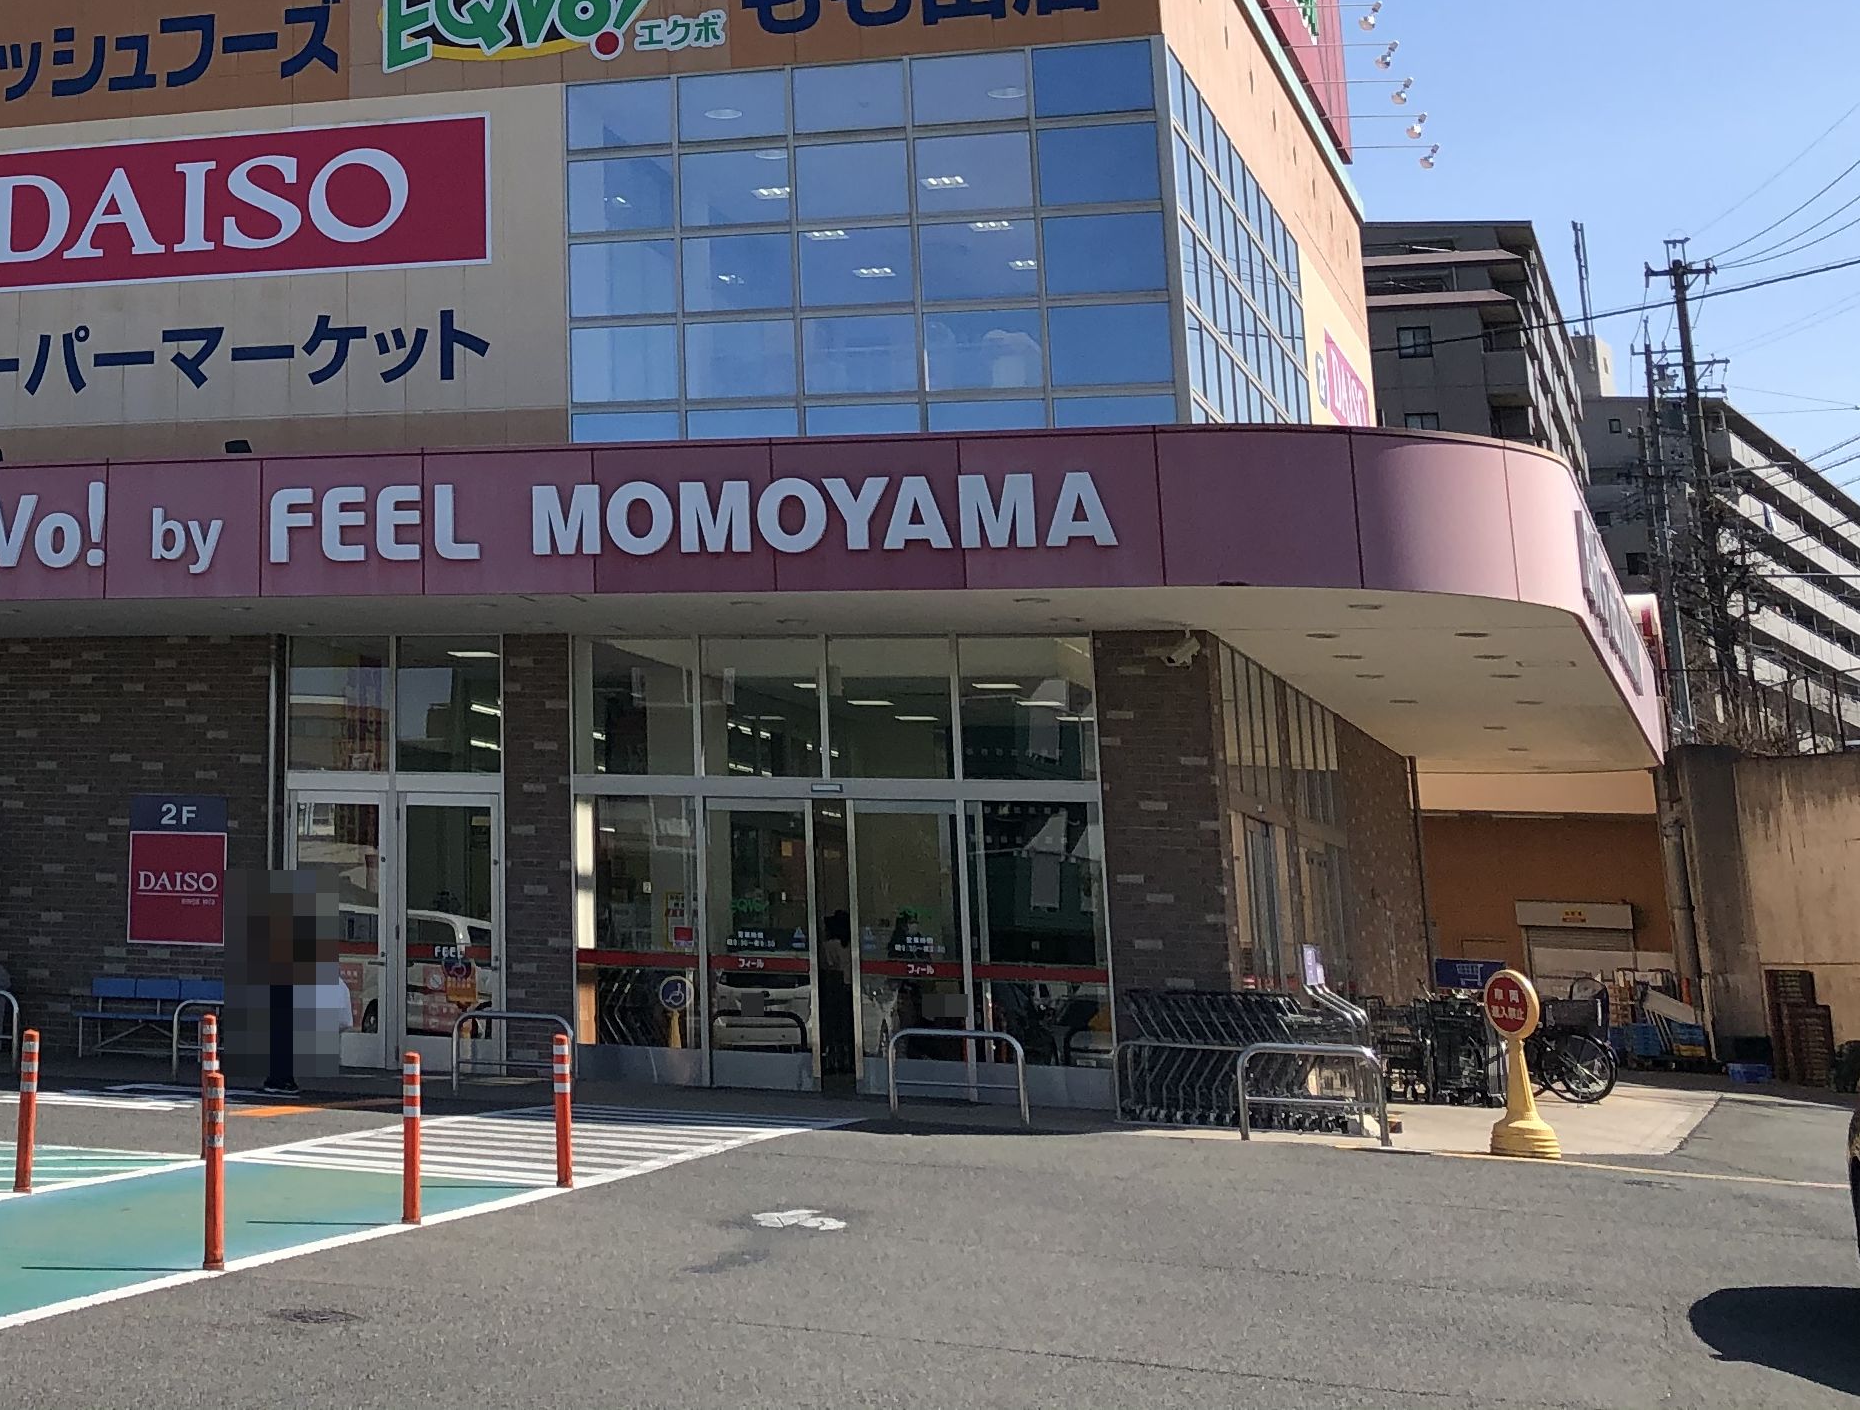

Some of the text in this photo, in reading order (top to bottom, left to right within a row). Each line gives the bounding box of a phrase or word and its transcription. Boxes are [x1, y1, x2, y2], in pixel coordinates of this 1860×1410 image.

[634, 9, 727, 51] エクボ
[151, 507, 223, 574] by
[269, 484, 480, 563] FEEL
[532, 471, 1119, 555] MOMOYAMA
[160, 803, 197, 825] 2F
[138, 870, 217, 892] DAISO
